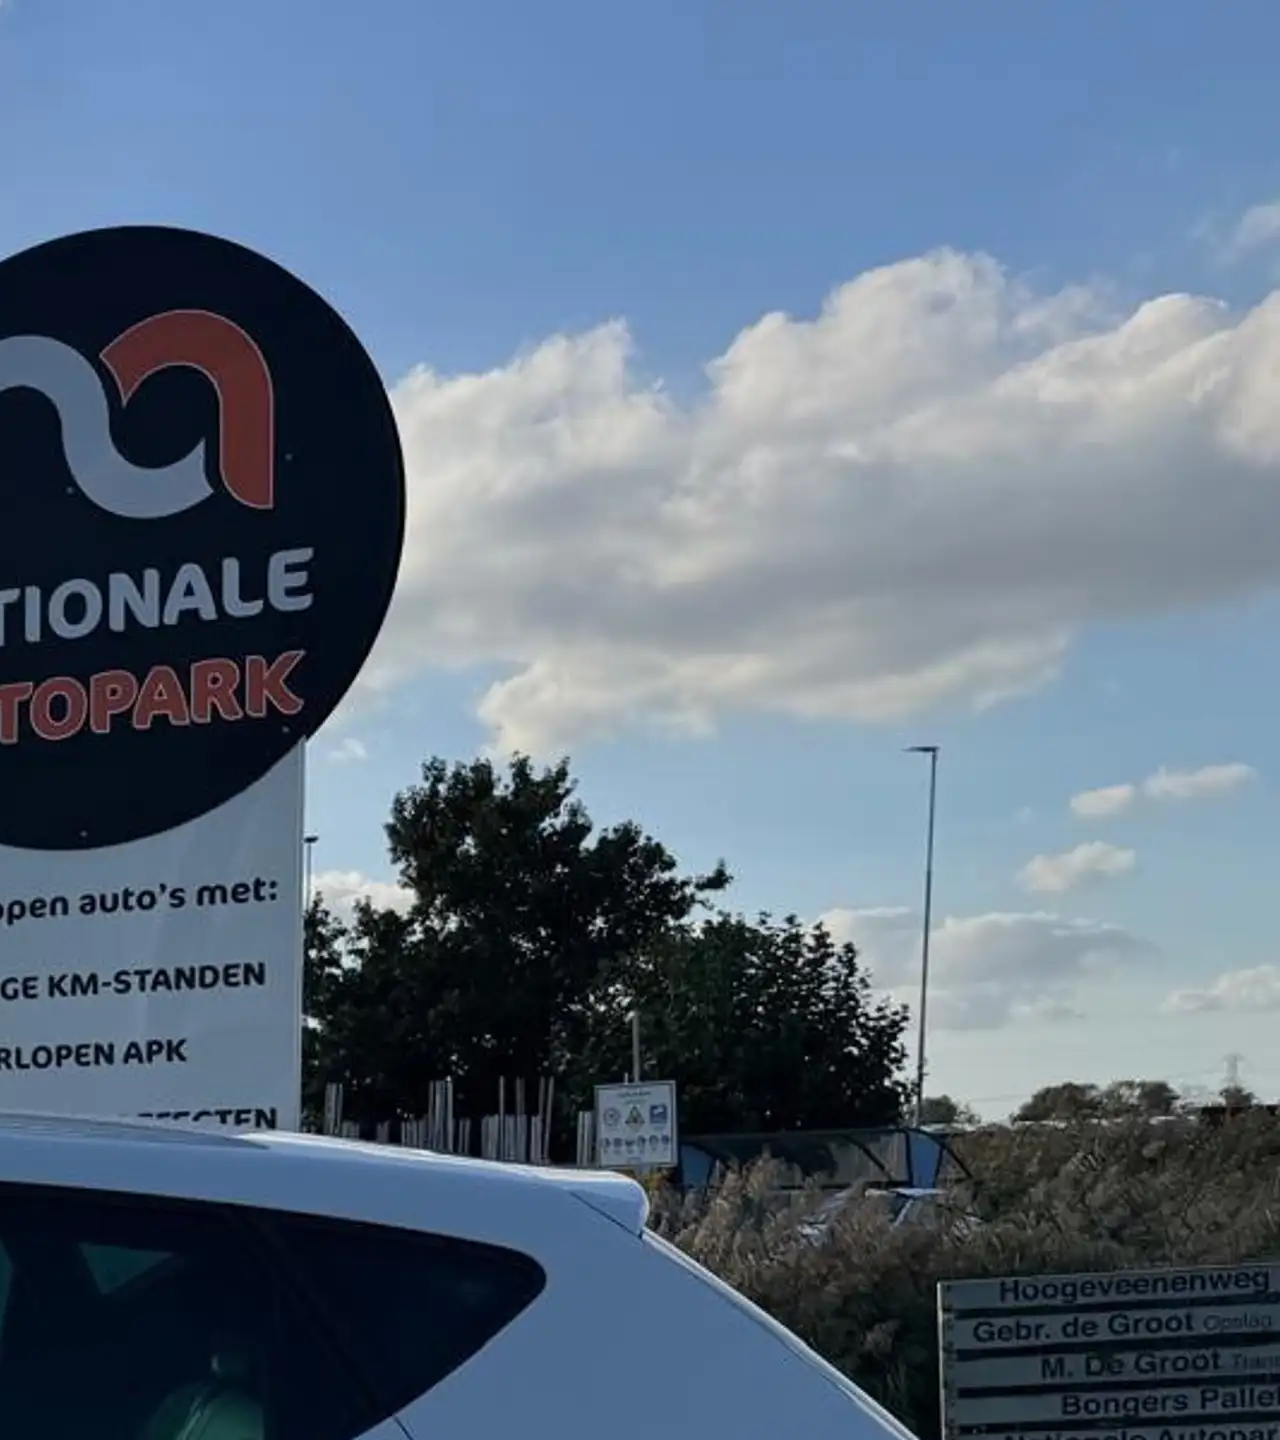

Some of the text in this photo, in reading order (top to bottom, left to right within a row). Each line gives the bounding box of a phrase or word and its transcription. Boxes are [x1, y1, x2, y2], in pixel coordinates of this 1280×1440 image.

[79, 883, 186, 914] auto's
[197, 877, 278, 907] met:
[48, 962, 266, 998] KM-STANDEN
[123, 1039, 187, 1064] APK
[1000, 1270, 1271, 1303] Hoogeveenenweg
[973, 1320, 1051, 1344] Gebr.
[1062, 1315, 1099, 1338] de
[1108, 1312, 1194, 1336] Groot
[1041, 1357, 1074, 1380] M.
[1085, 1354, 1125, 1378] De
[1134, 1349, 1221, 1375] Groot
[1062, 1385, 1280, 1418] Bongers Palle
